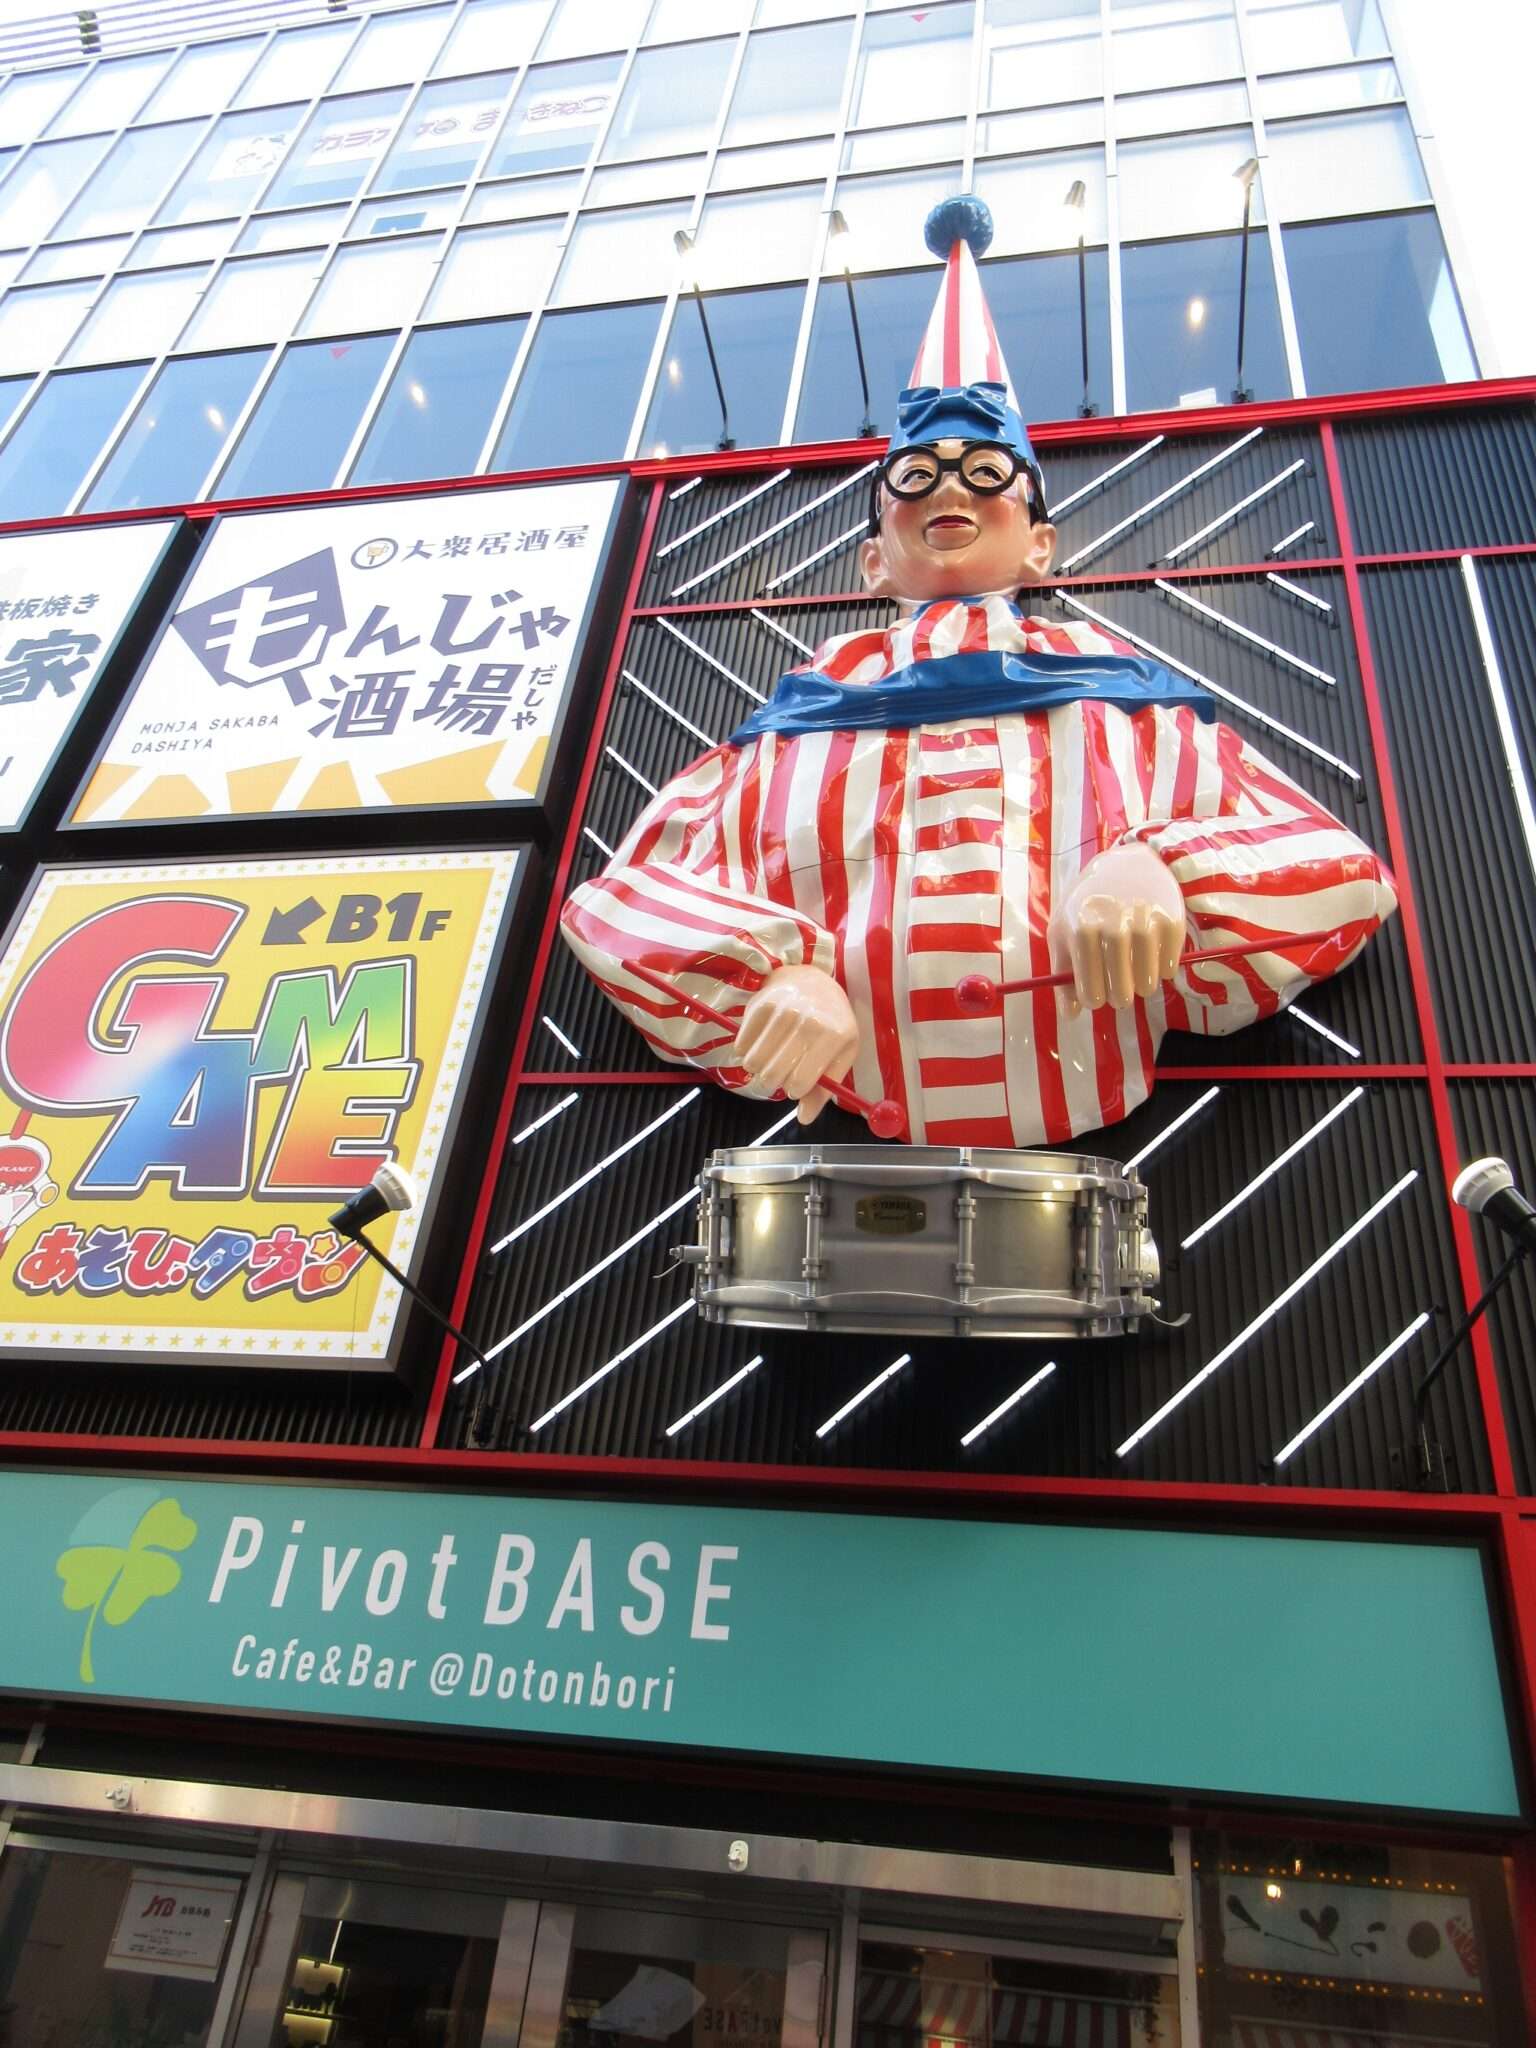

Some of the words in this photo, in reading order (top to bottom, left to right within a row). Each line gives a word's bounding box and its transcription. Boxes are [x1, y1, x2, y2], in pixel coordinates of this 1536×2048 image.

[401, 525, 589, 562] 大衆居酒屋
[204, 586, 571, 686] もんじゃ
[140, 720, 198, 735] MONJA
[208, 715, 280, 731] SAKABA
[307, 664, 524, 739] 酒場
[511, 664, 558, 731] だしや
[131, 738, 214, 754] DASHIYA
[326, 892, 453, 944] B1F
[0, 893, 420, 1201] GAME
[207, 1515, 458, 1620] Pivot
[483, 1533, 739, 1641] BASE
[231, 1633, 416, 1691] Cafe&Bar
[429, 1652, 676, 1712] @Dotonbori
[141, 1895, 177, 1918] JTB
